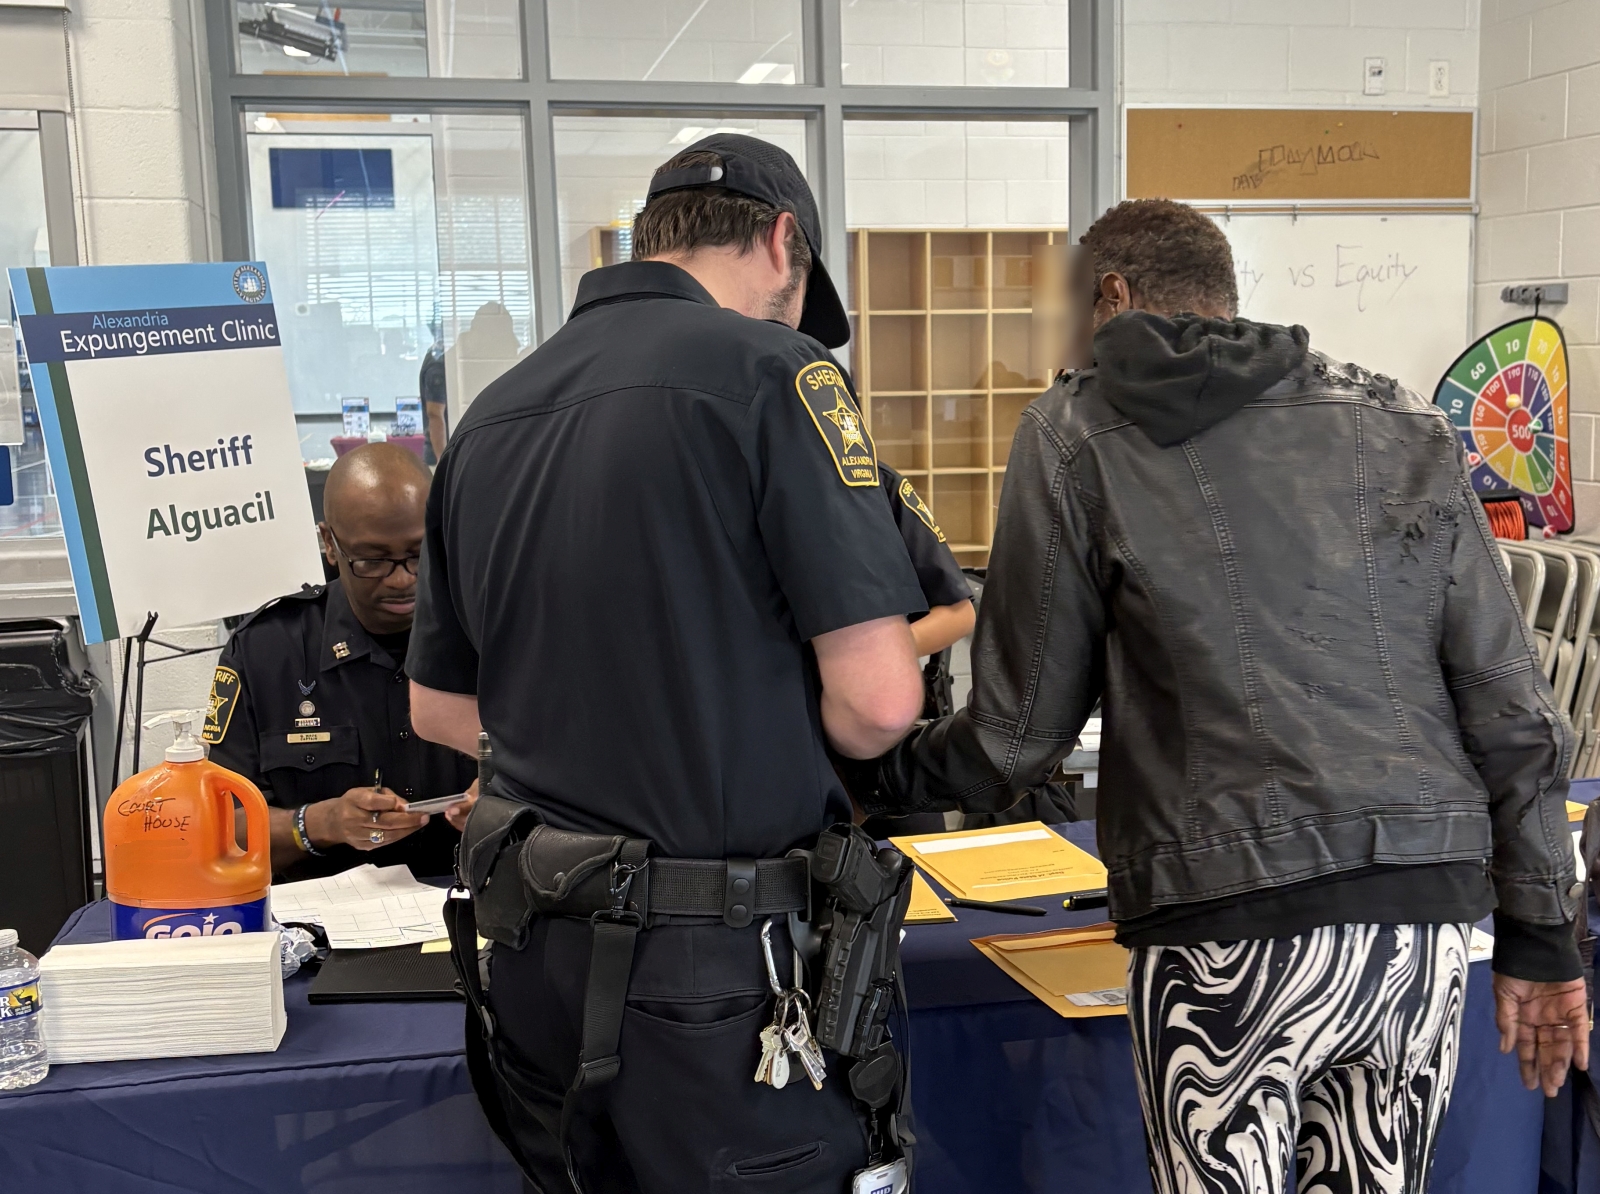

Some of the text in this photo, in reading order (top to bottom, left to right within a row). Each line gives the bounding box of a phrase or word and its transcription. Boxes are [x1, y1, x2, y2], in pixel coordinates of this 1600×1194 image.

[1289, 264, 1315, 288] vs
[1335, 244, 1418, 312] Equity
[92, 312, 169, 329] Alexandria
[60, 318, 276, 357] Expungement Clinic
[1505, 338, 1521, 355] 10
[1470, 361, 1486, 381] 60
[1507, 366, 1521, 380] 190
[1486, 381, 1501, 397] 100
[1449, 398, 1464, 415] 10
[1475, 404, 1486, 422] 160
[1512, 424, 1531, 440] 500
[1477, 433, 1489, 451] 150
[144, 435, 253, 478] Sheriff
[146, 491, 275, 542] Alguacil
[215, 670, 236, 685] RIFF
[118, 797, 176, 816] COURT
[144, 816, 191, 832] HOUSE
[0, 996, 10, 1007] R
[0, 1007, 13, 1020] K
